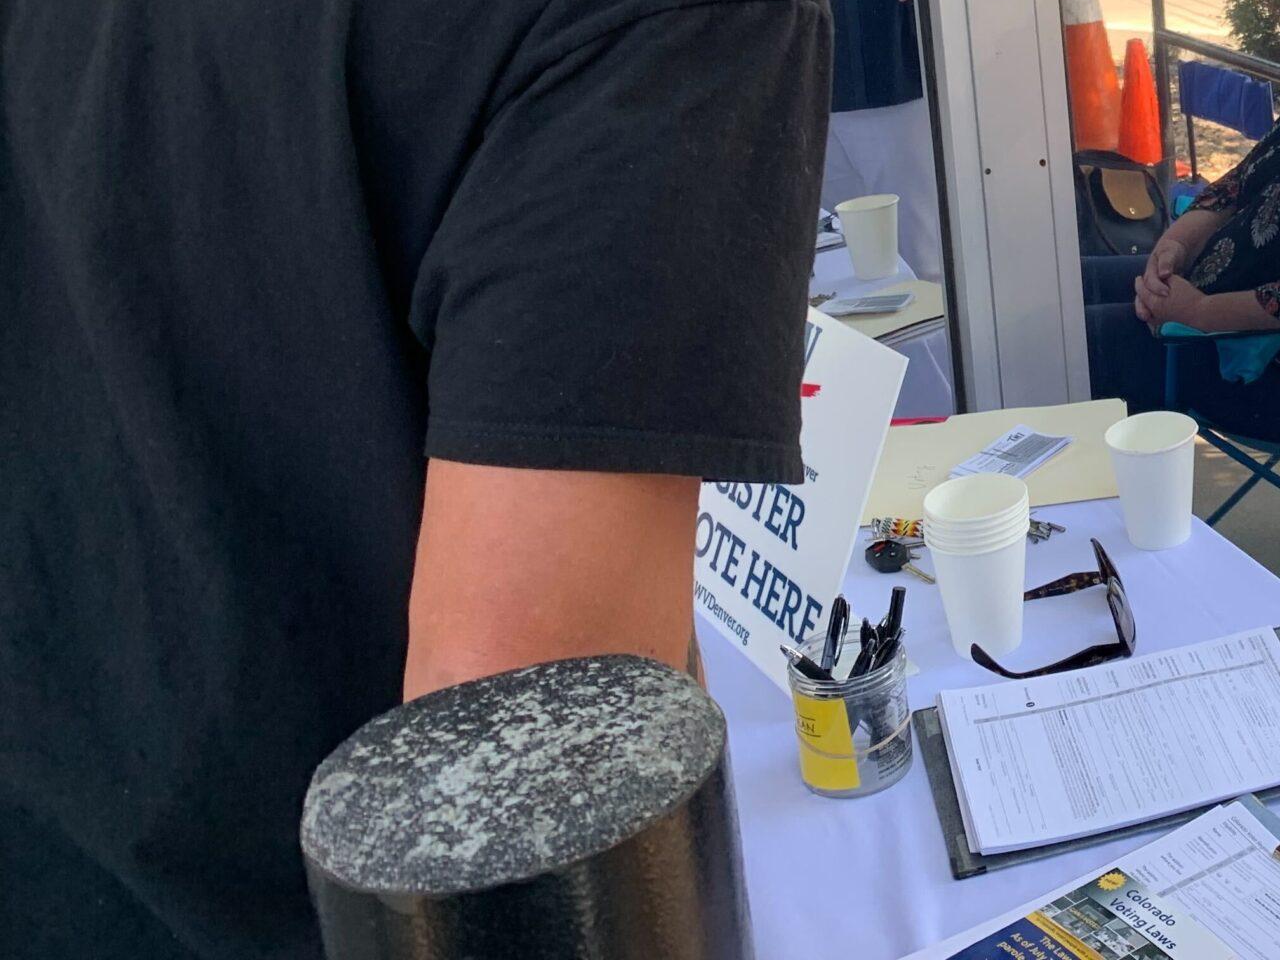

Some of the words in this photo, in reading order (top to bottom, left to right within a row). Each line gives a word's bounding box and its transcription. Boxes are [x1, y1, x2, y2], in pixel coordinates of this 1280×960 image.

[804, 464, 819, 483] ver
[694, 511, 747, 588] OTE
[740, 550, 824, 646] HERE
[693, 580, 751, 647] WVDenver.org
[1109, 898, 1148, 929] Voting
[1144, 924, 1177, 950] Laws
[1126, 889, 1176, 927] Colorado
[1010, 933, 1023, 943] As
[1020, 940, 1035, 949] of
[1028, 947, 1048, 960] July
[1040, 936, 1056, 950] The
